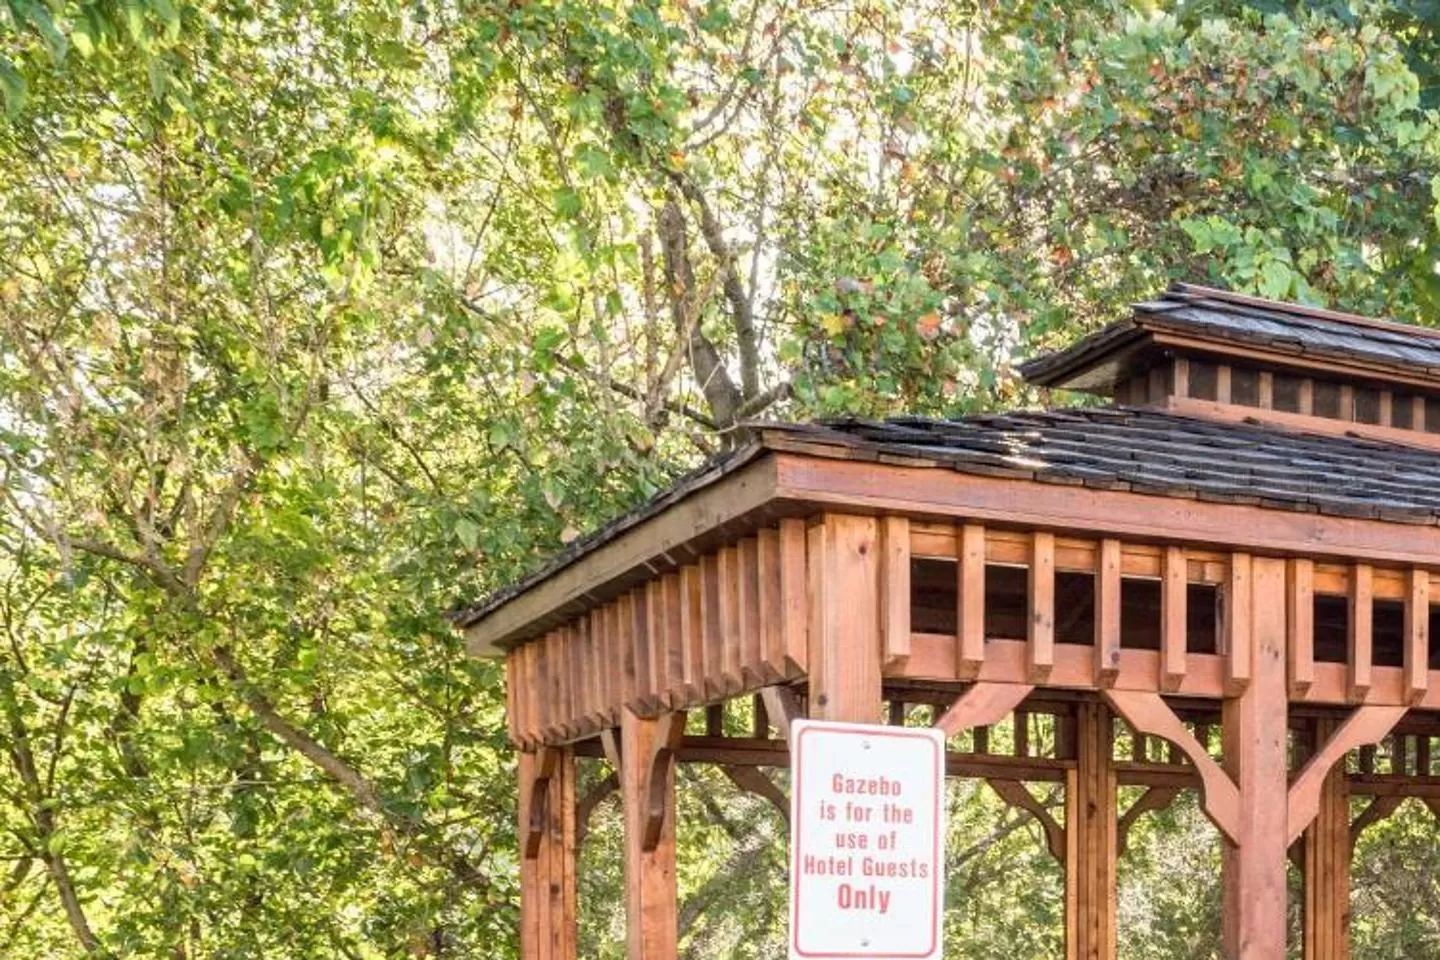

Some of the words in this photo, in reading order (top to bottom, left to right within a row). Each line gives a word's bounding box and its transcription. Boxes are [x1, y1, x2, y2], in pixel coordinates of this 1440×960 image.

[832, 773, 901, 797] Gazebo
[820, 800, 836, 821] is
[846, 802, 873, 823] for
[883, 803, 913, 824] the
[836, 832, 868, 849] use
[878, 830, 897, 850] of
[804, 854, 853, 876] Hotel
[862, 857, 929, 878] Guests
[837, 883, 891, 913] Only
